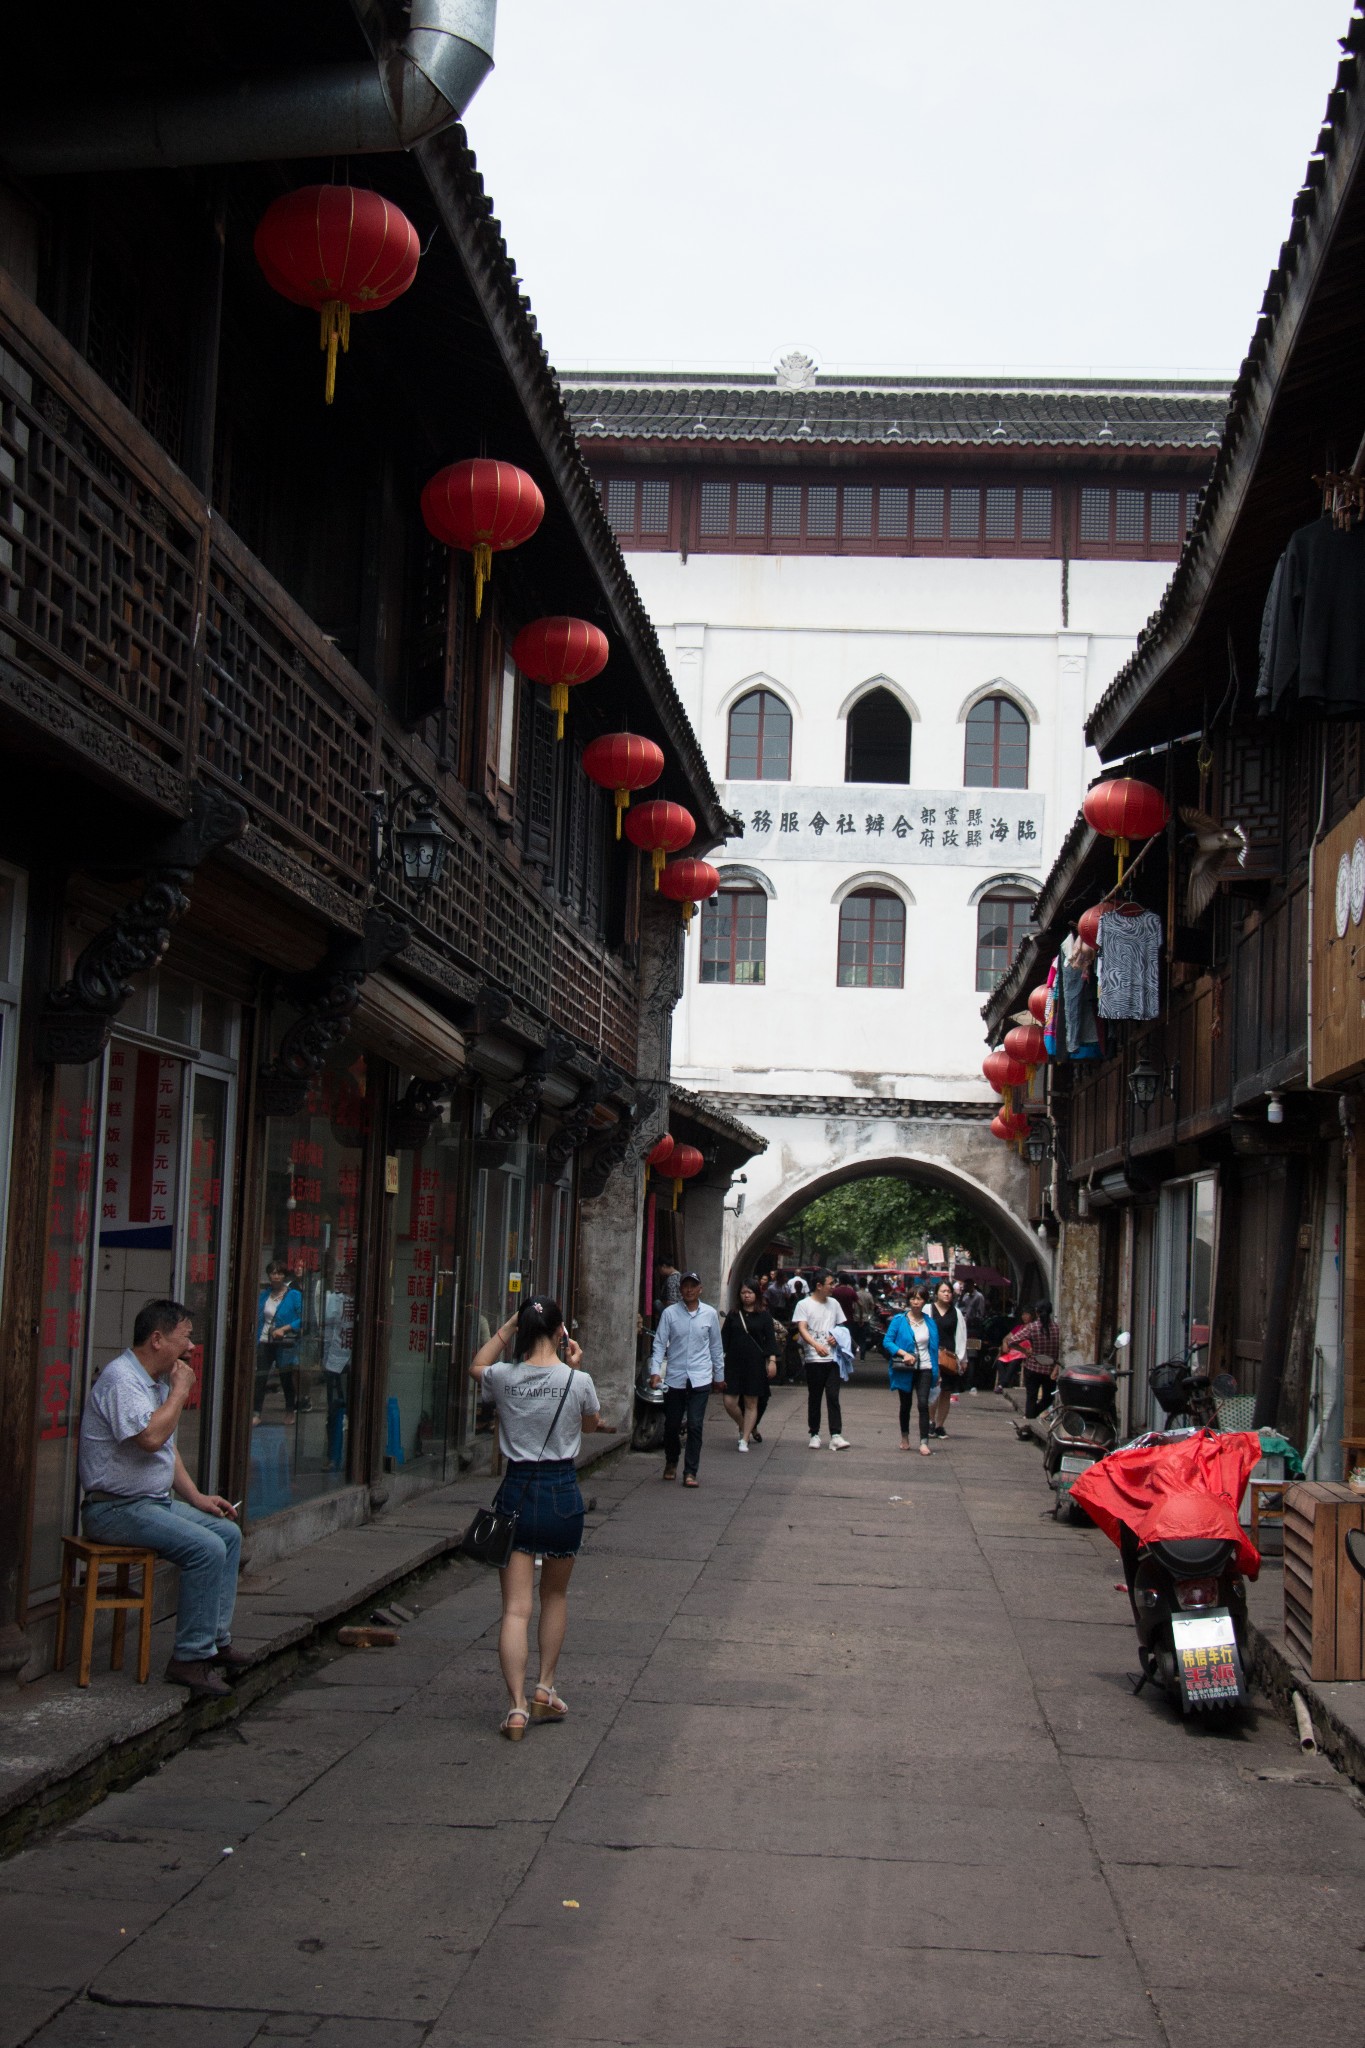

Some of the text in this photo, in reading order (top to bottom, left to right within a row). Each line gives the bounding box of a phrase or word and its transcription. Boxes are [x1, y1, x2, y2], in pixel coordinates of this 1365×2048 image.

[732, 808, 914, 839] 合辦社會服務
[159, 1079, 173, 1094] 元
[157, 1105, 171, 1119] 元
[156, 1130, 170, 1144] 元
[154, 1155, 168, 1170] 元
[153, 1180, 167, 1195] 元
[151, 1206, 166, 1221] 元
[504, 1386, 566, 1398] REVAMPED
[1182, 1645, 1233, 1668] 伟信车行
